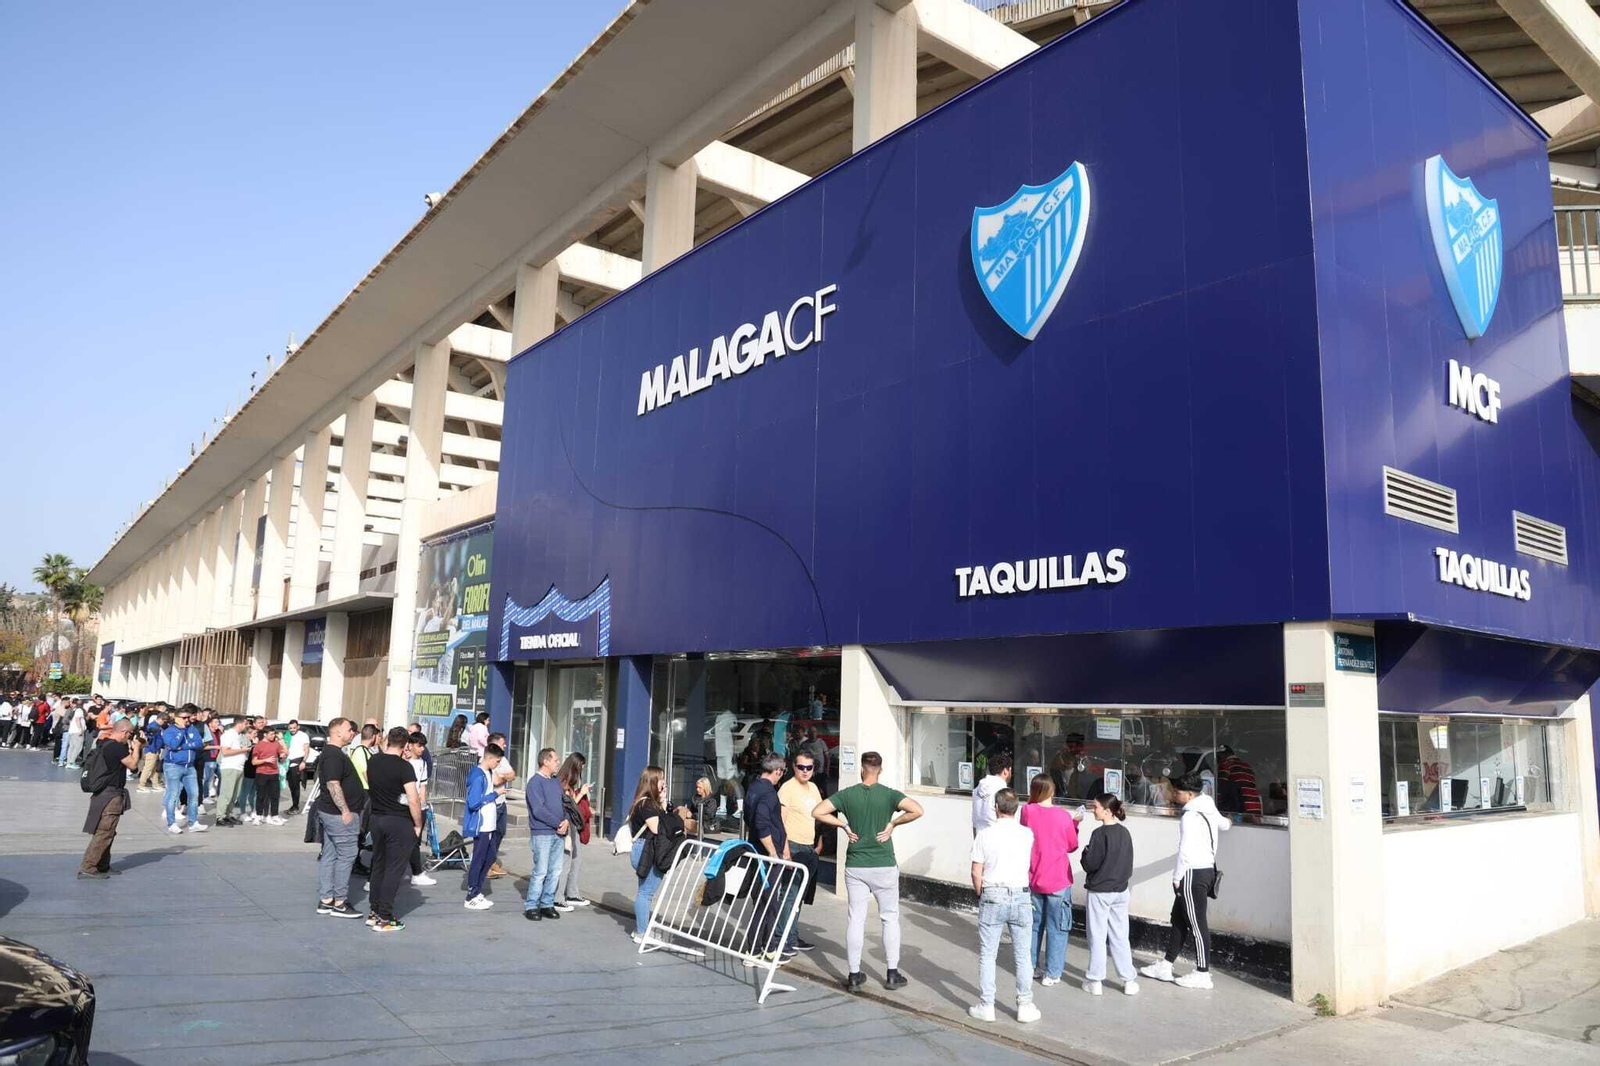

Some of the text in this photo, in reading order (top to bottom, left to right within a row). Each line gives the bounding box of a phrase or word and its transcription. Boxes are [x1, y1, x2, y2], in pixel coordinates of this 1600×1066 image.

[1449, 358, 1502, 425] MCF
[955, 548, 1128, 597] TAQUILLAS
[1436, 547, 1531, 601] TAQUILLAS
[520, 632, 579, 650] TIENDA OFICIAL
